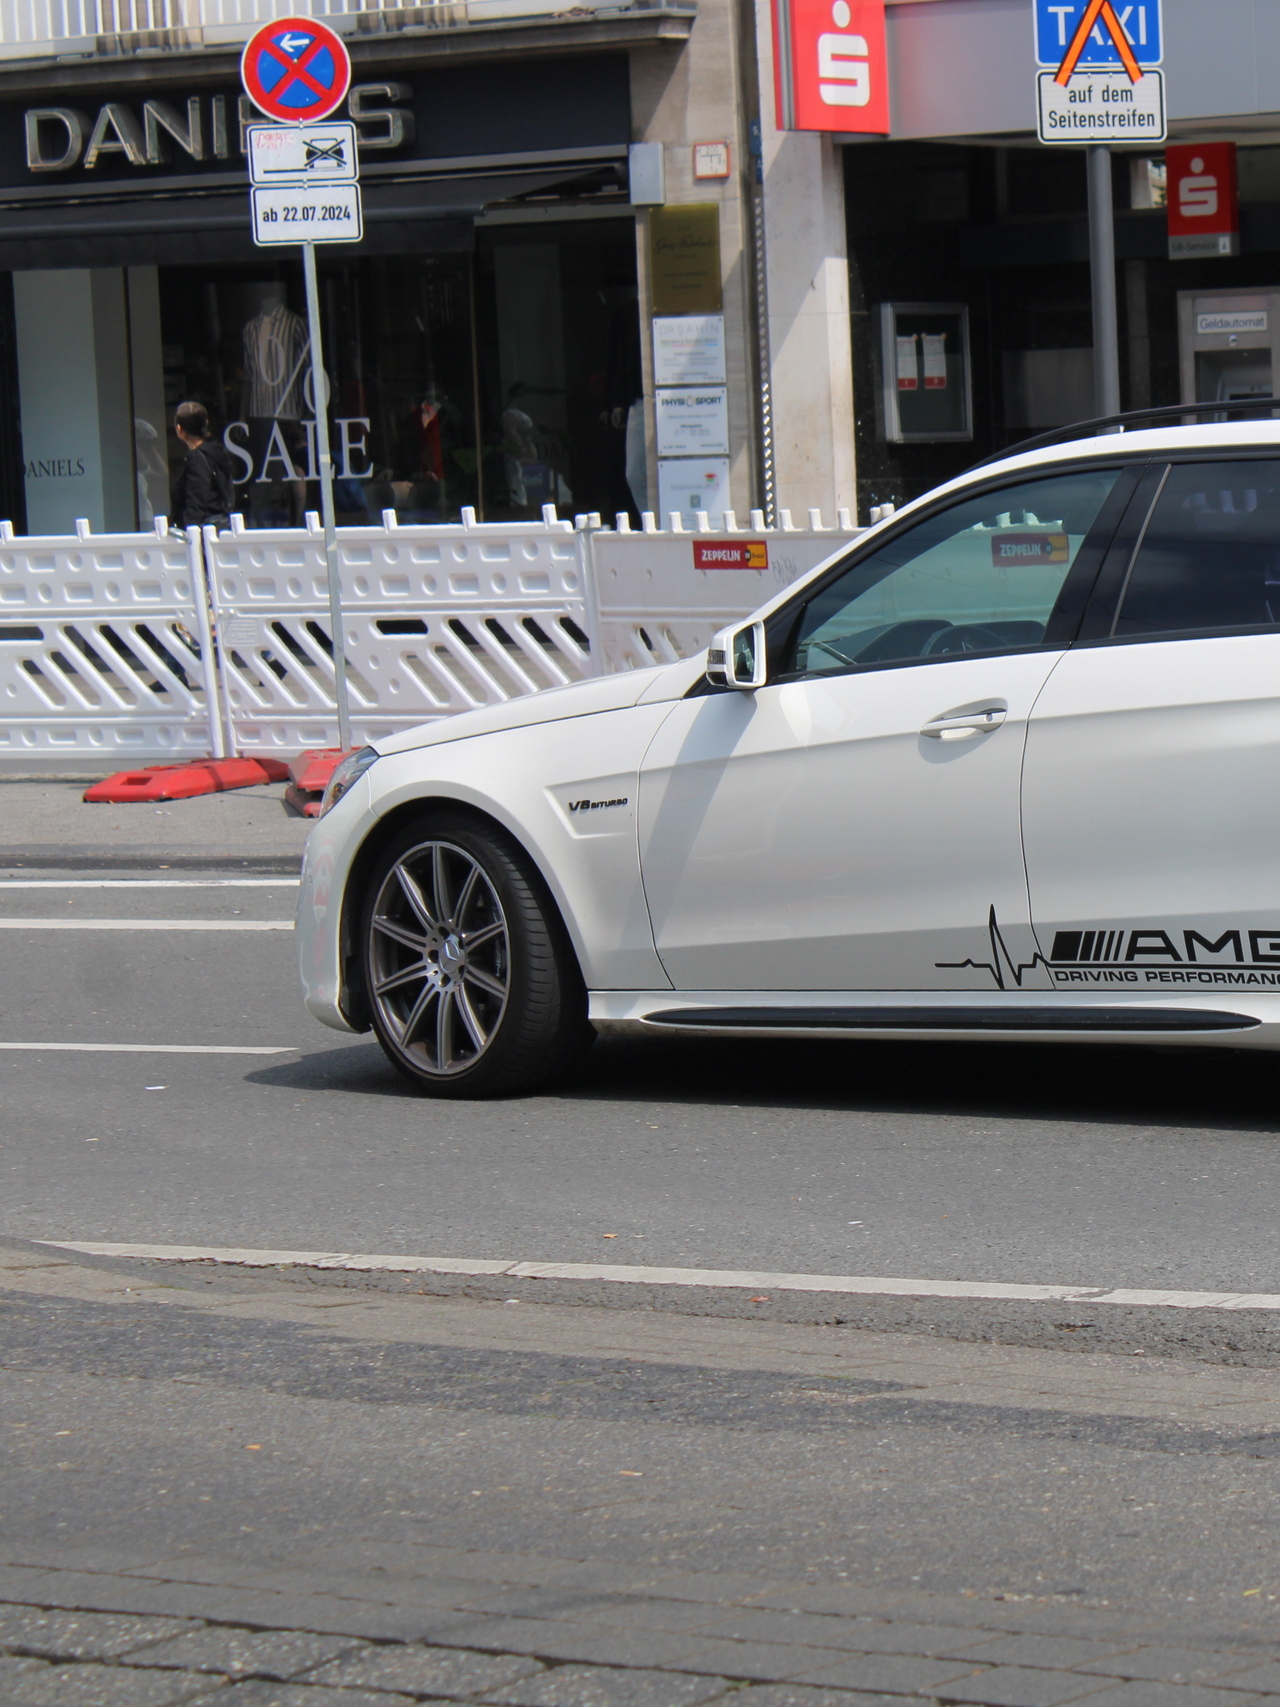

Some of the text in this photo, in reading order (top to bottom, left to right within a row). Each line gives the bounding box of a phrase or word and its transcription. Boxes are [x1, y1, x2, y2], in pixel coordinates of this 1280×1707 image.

[1069, 84, 1133, 103] auf dem
[1049, 109, 1155, 128] Seitenstreifen
[263, 205, 351, 222] ab 22.07.2024
[1200, 317, 1264, 330] Geldautomat
[223, 417, 374, 485] SALE
[702, 549, 741, 561] ZEPPELIN
[1000, 544, 1041, 557] ZEPPELIN
[568, 800, 591, 811] V8
[1055, 970, 1138, 983] DRIVING
